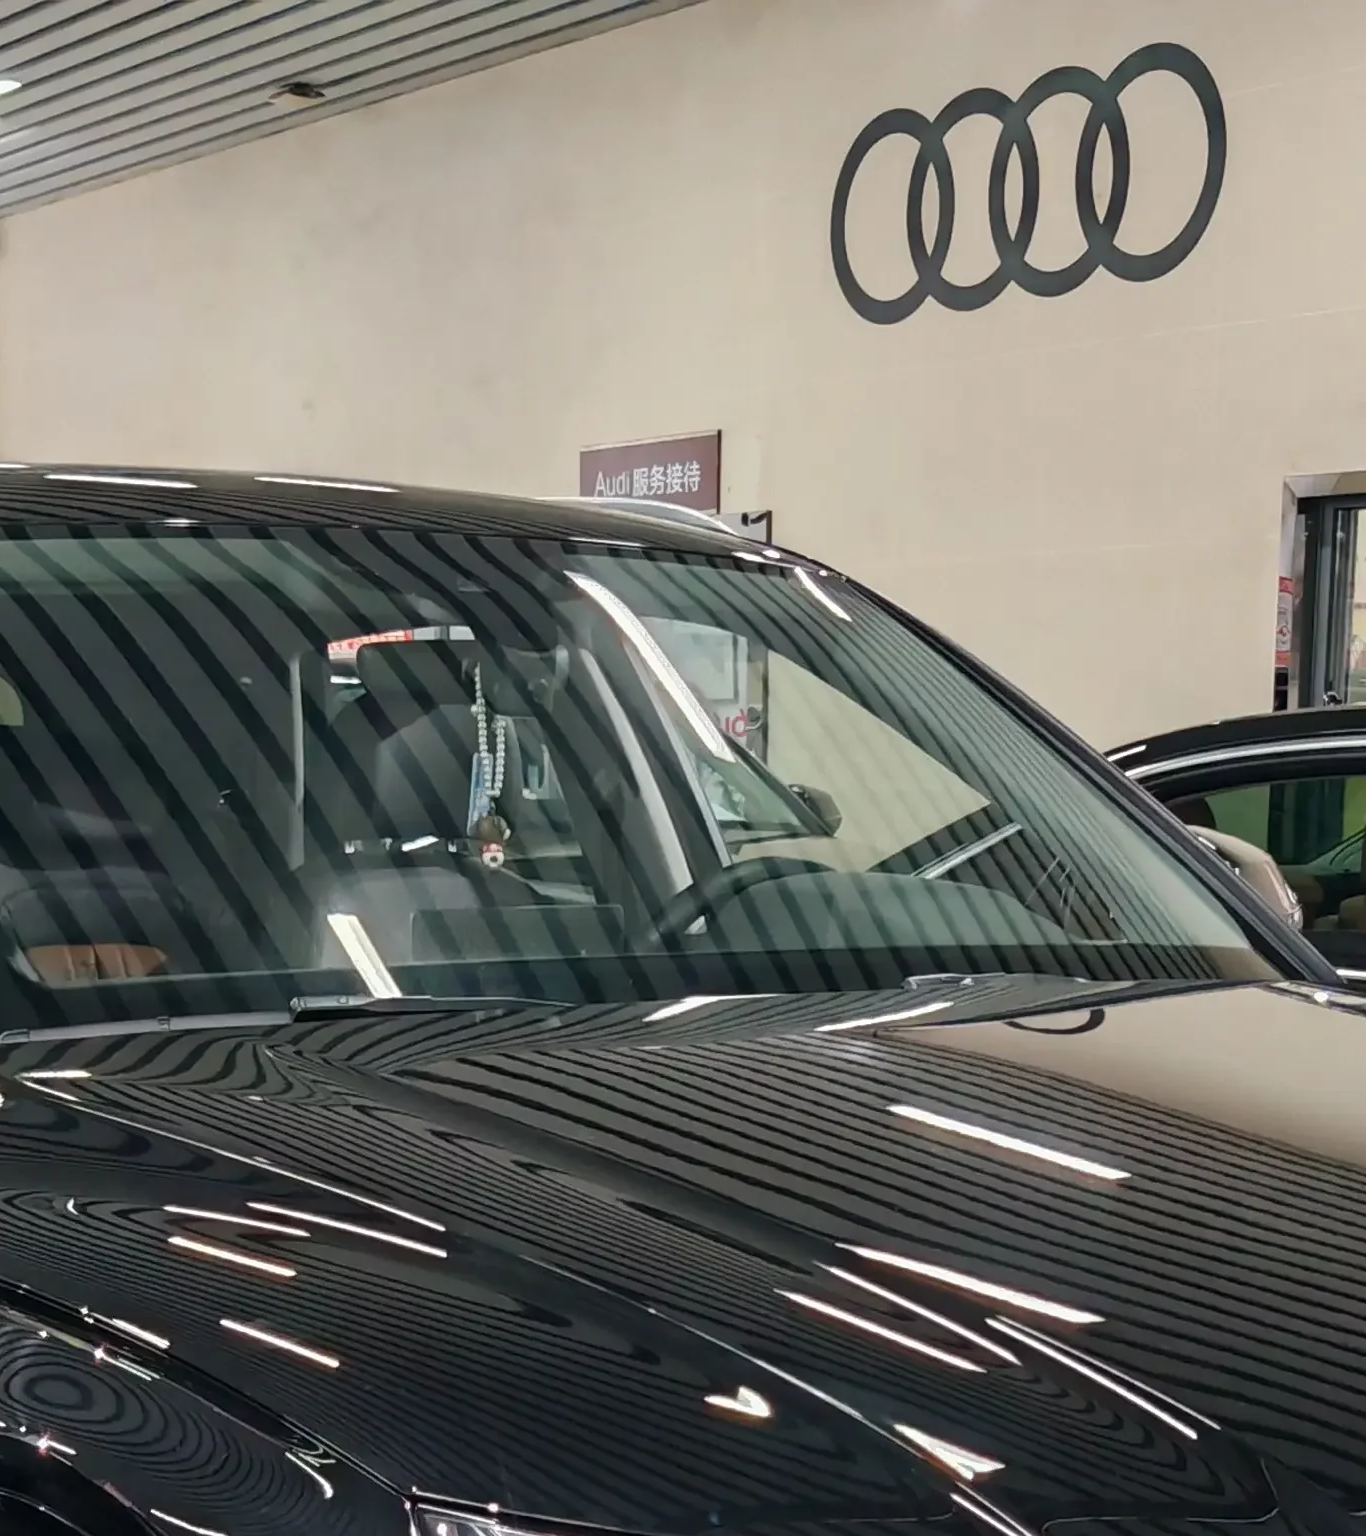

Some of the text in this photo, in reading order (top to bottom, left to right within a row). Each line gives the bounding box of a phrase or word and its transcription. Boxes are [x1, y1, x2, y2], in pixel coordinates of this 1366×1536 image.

[594, 461, 701, 498] Audi 服务接待
